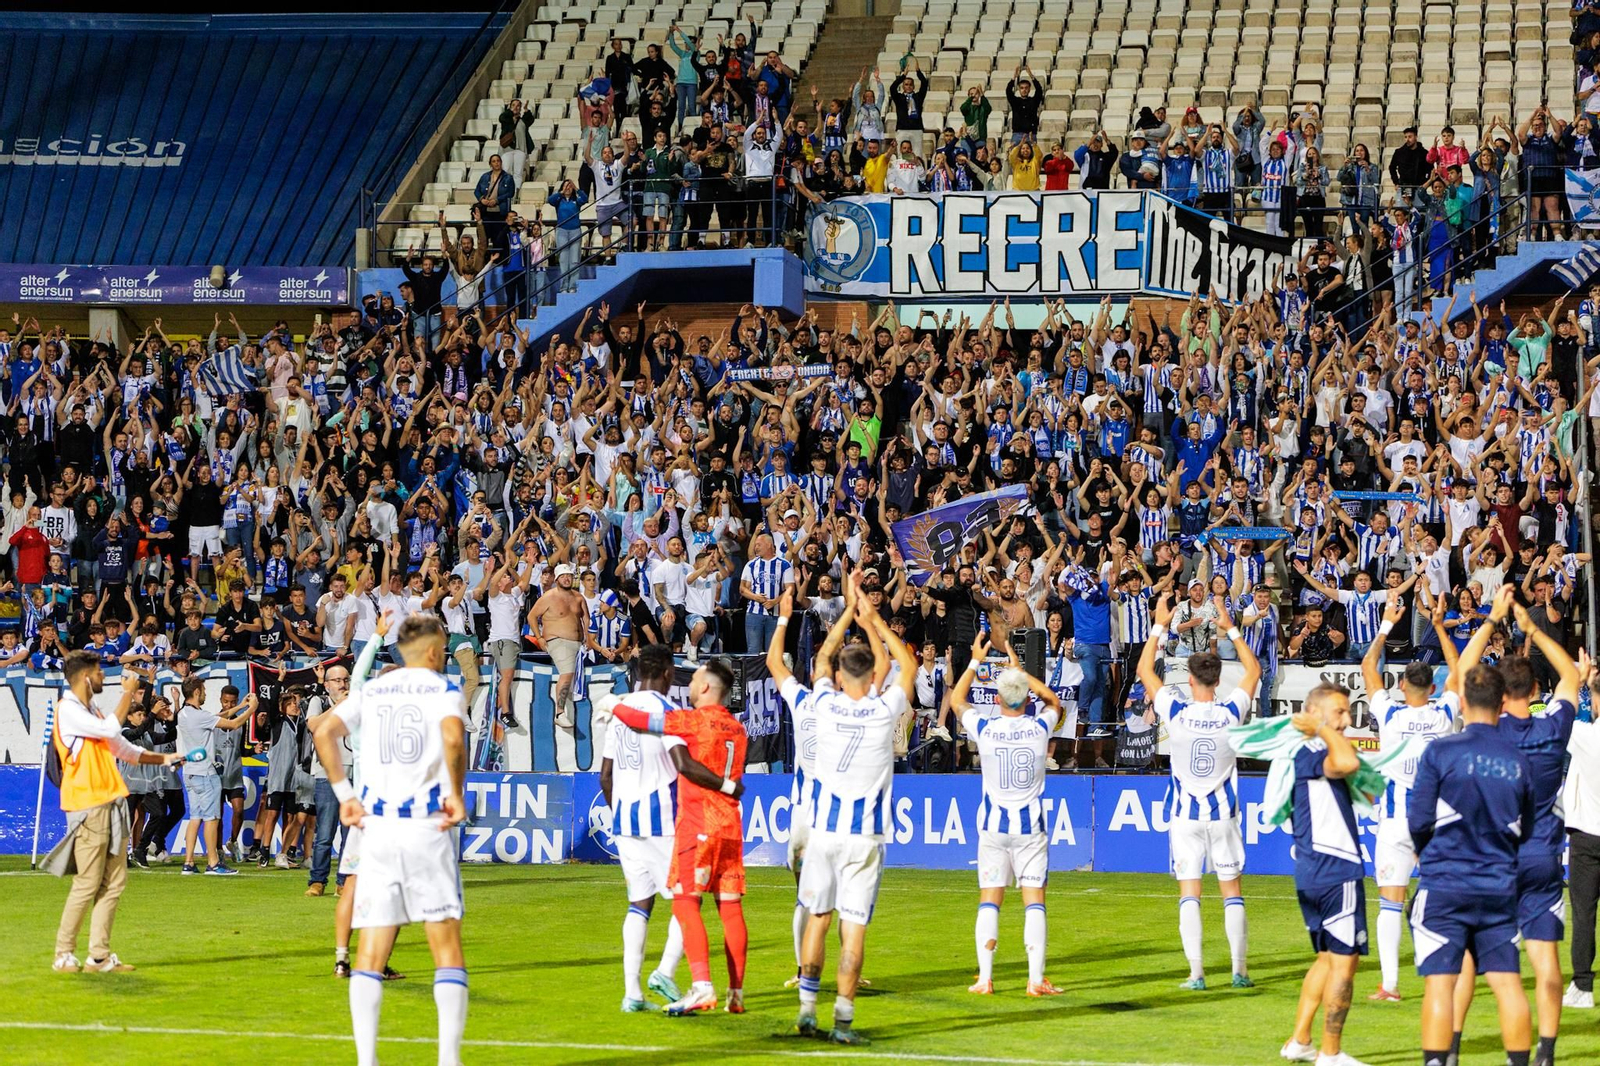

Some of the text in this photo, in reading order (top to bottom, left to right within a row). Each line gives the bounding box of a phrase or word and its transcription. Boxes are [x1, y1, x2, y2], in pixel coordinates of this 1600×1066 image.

[887, 192, 1142, 294] RECRE
[1148, 193, 1203, 293] The
[20, 275, 51, 286] alter
[110, 277, 140, 288] alter
[194, 277, 215, 288] alt
[279, 277, 309, 288] alter
[20, 287, 73, 297] enersun
[110, 287, 162, 298] enersun
[193, 288, 245, 298] enersun
[279, 288, 332, 298] enersun
[730, 365, 830, 380] FRENTE ONUBA
[47, 517, 64, 528] BR
[47, 528, 63, 539] NX
[260, 632, 281, 644] EA7
[377, 705, 423, 764] 16
[615, 723, 641, 770] 19
[836, 723, 865, 772] 7
[725, 741, 735, 780] 1
[1190, 738, 1216, 777] 6
[995, 747, 1035, 789] 18
[924, 797, 967, 844] LA
